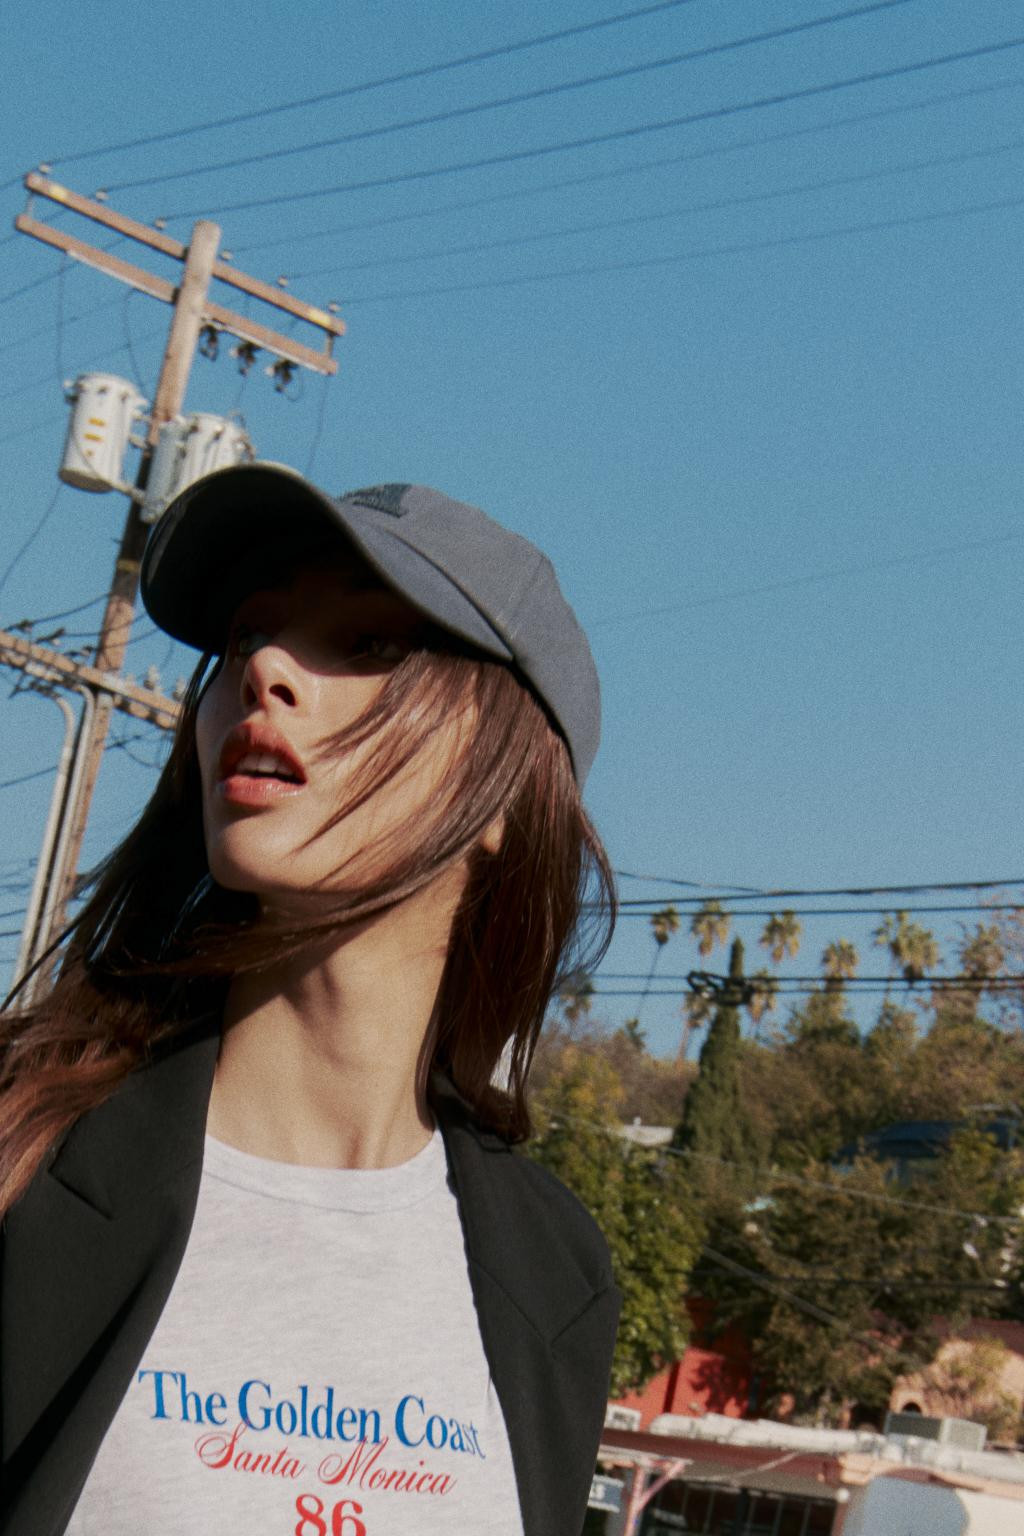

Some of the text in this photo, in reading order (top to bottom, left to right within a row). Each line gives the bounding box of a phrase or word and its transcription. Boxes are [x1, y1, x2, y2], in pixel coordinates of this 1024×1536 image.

[138, 1370, 486, 1459] The Golden Coast
[194, 1421, 457, 1496] Santa Monica
